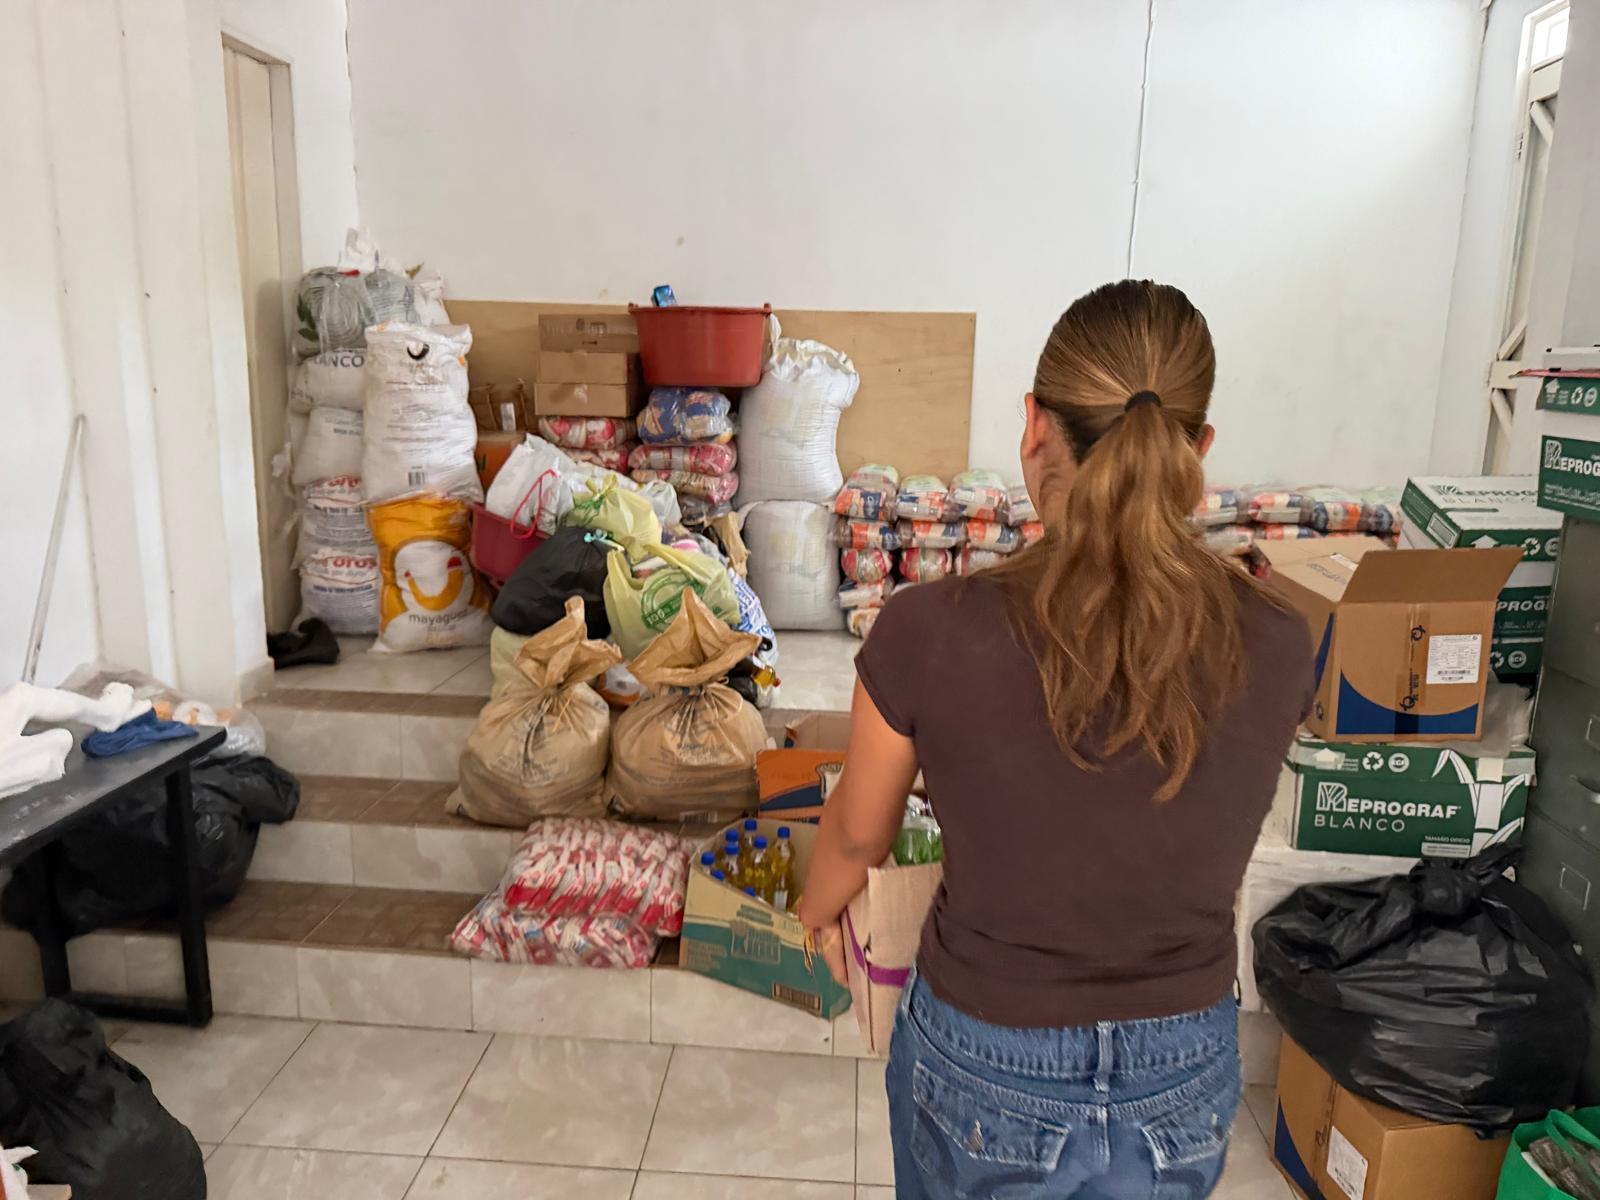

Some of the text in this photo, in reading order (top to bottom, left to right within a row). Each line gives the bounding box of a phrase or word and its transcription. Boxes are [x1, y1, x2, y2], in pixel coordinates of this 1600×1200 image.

[1497, 600, 1549, 613] PROG
[1315, 781, 1458, 819] REPROGRAF
[1314, 814, 1406, 833] BLANCO
